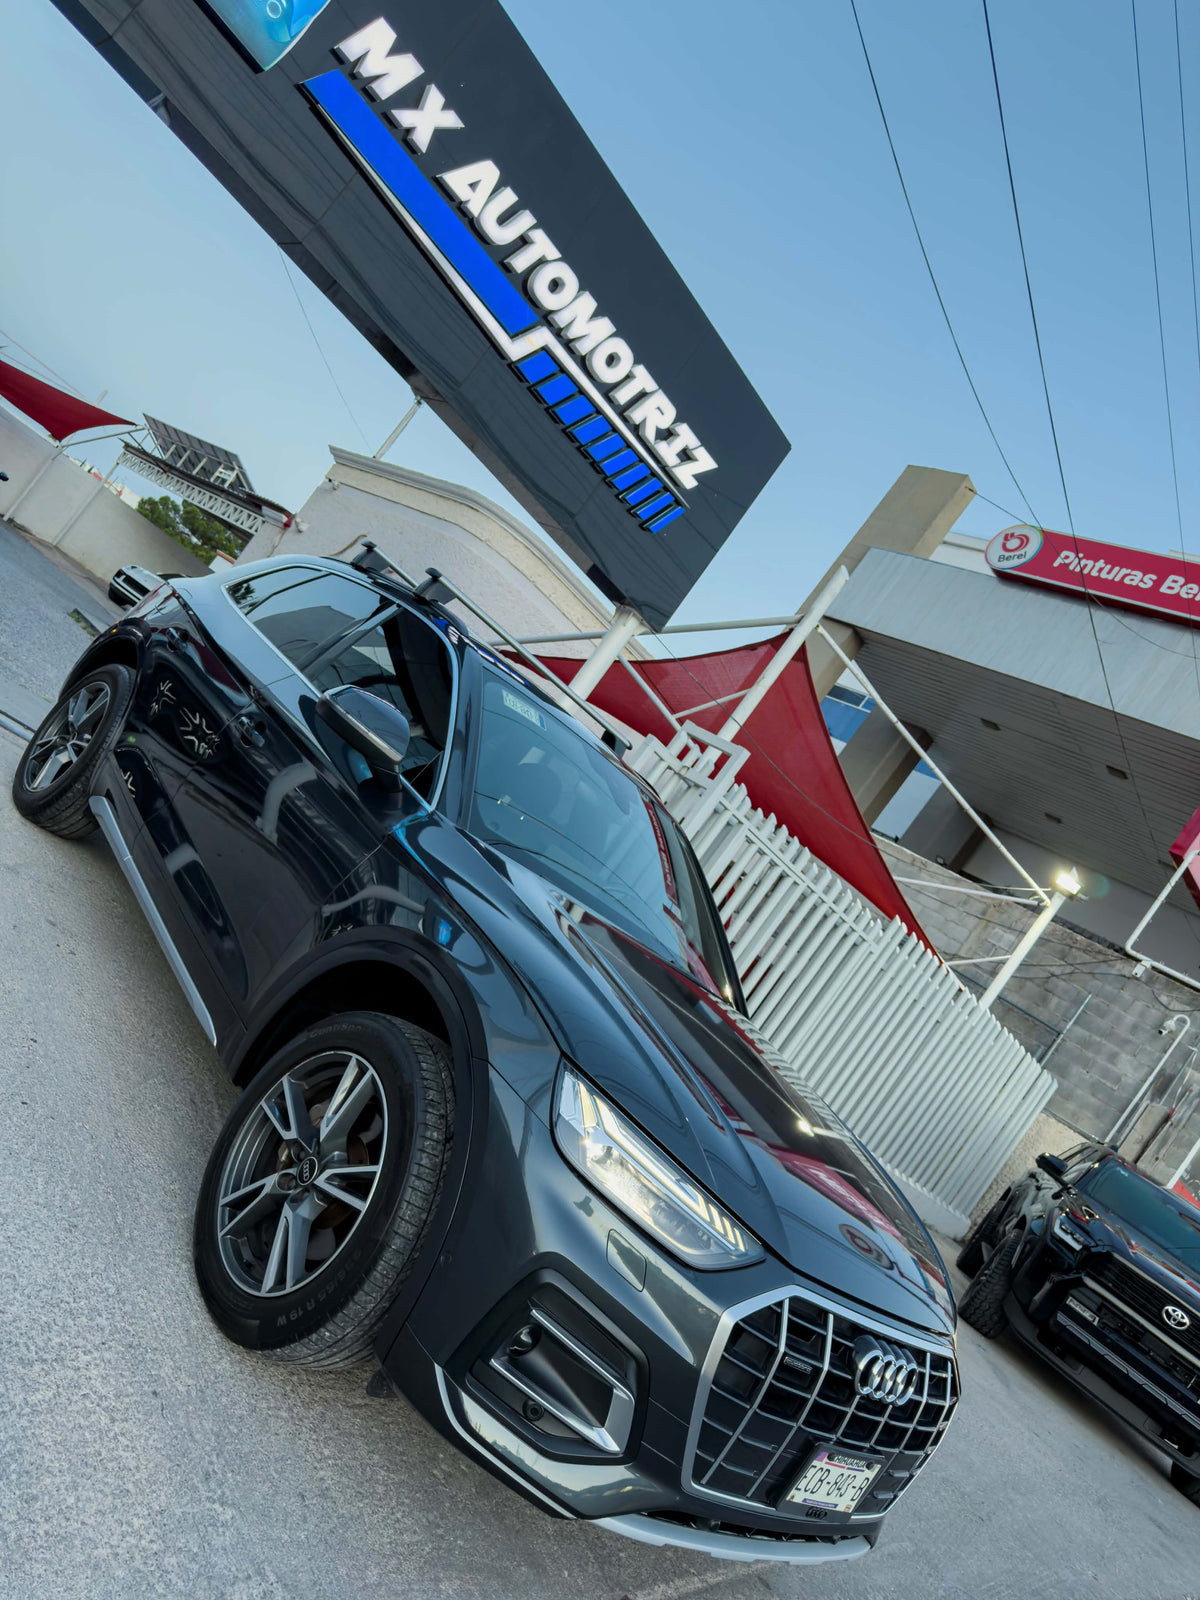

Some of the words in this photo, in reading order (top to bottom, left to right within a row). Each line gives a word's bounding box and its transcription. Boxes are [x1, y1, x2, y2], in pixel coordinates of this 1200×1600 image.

[334, 16, 465, 154] MX
[436, 159, 719, 490] AUTOMOTRIZ
[998, 551, 1027, 563] Berel
[1053, 550, 1158, 589] Pinturas
[795, 1464, 870, 1502] ECB-843-B
